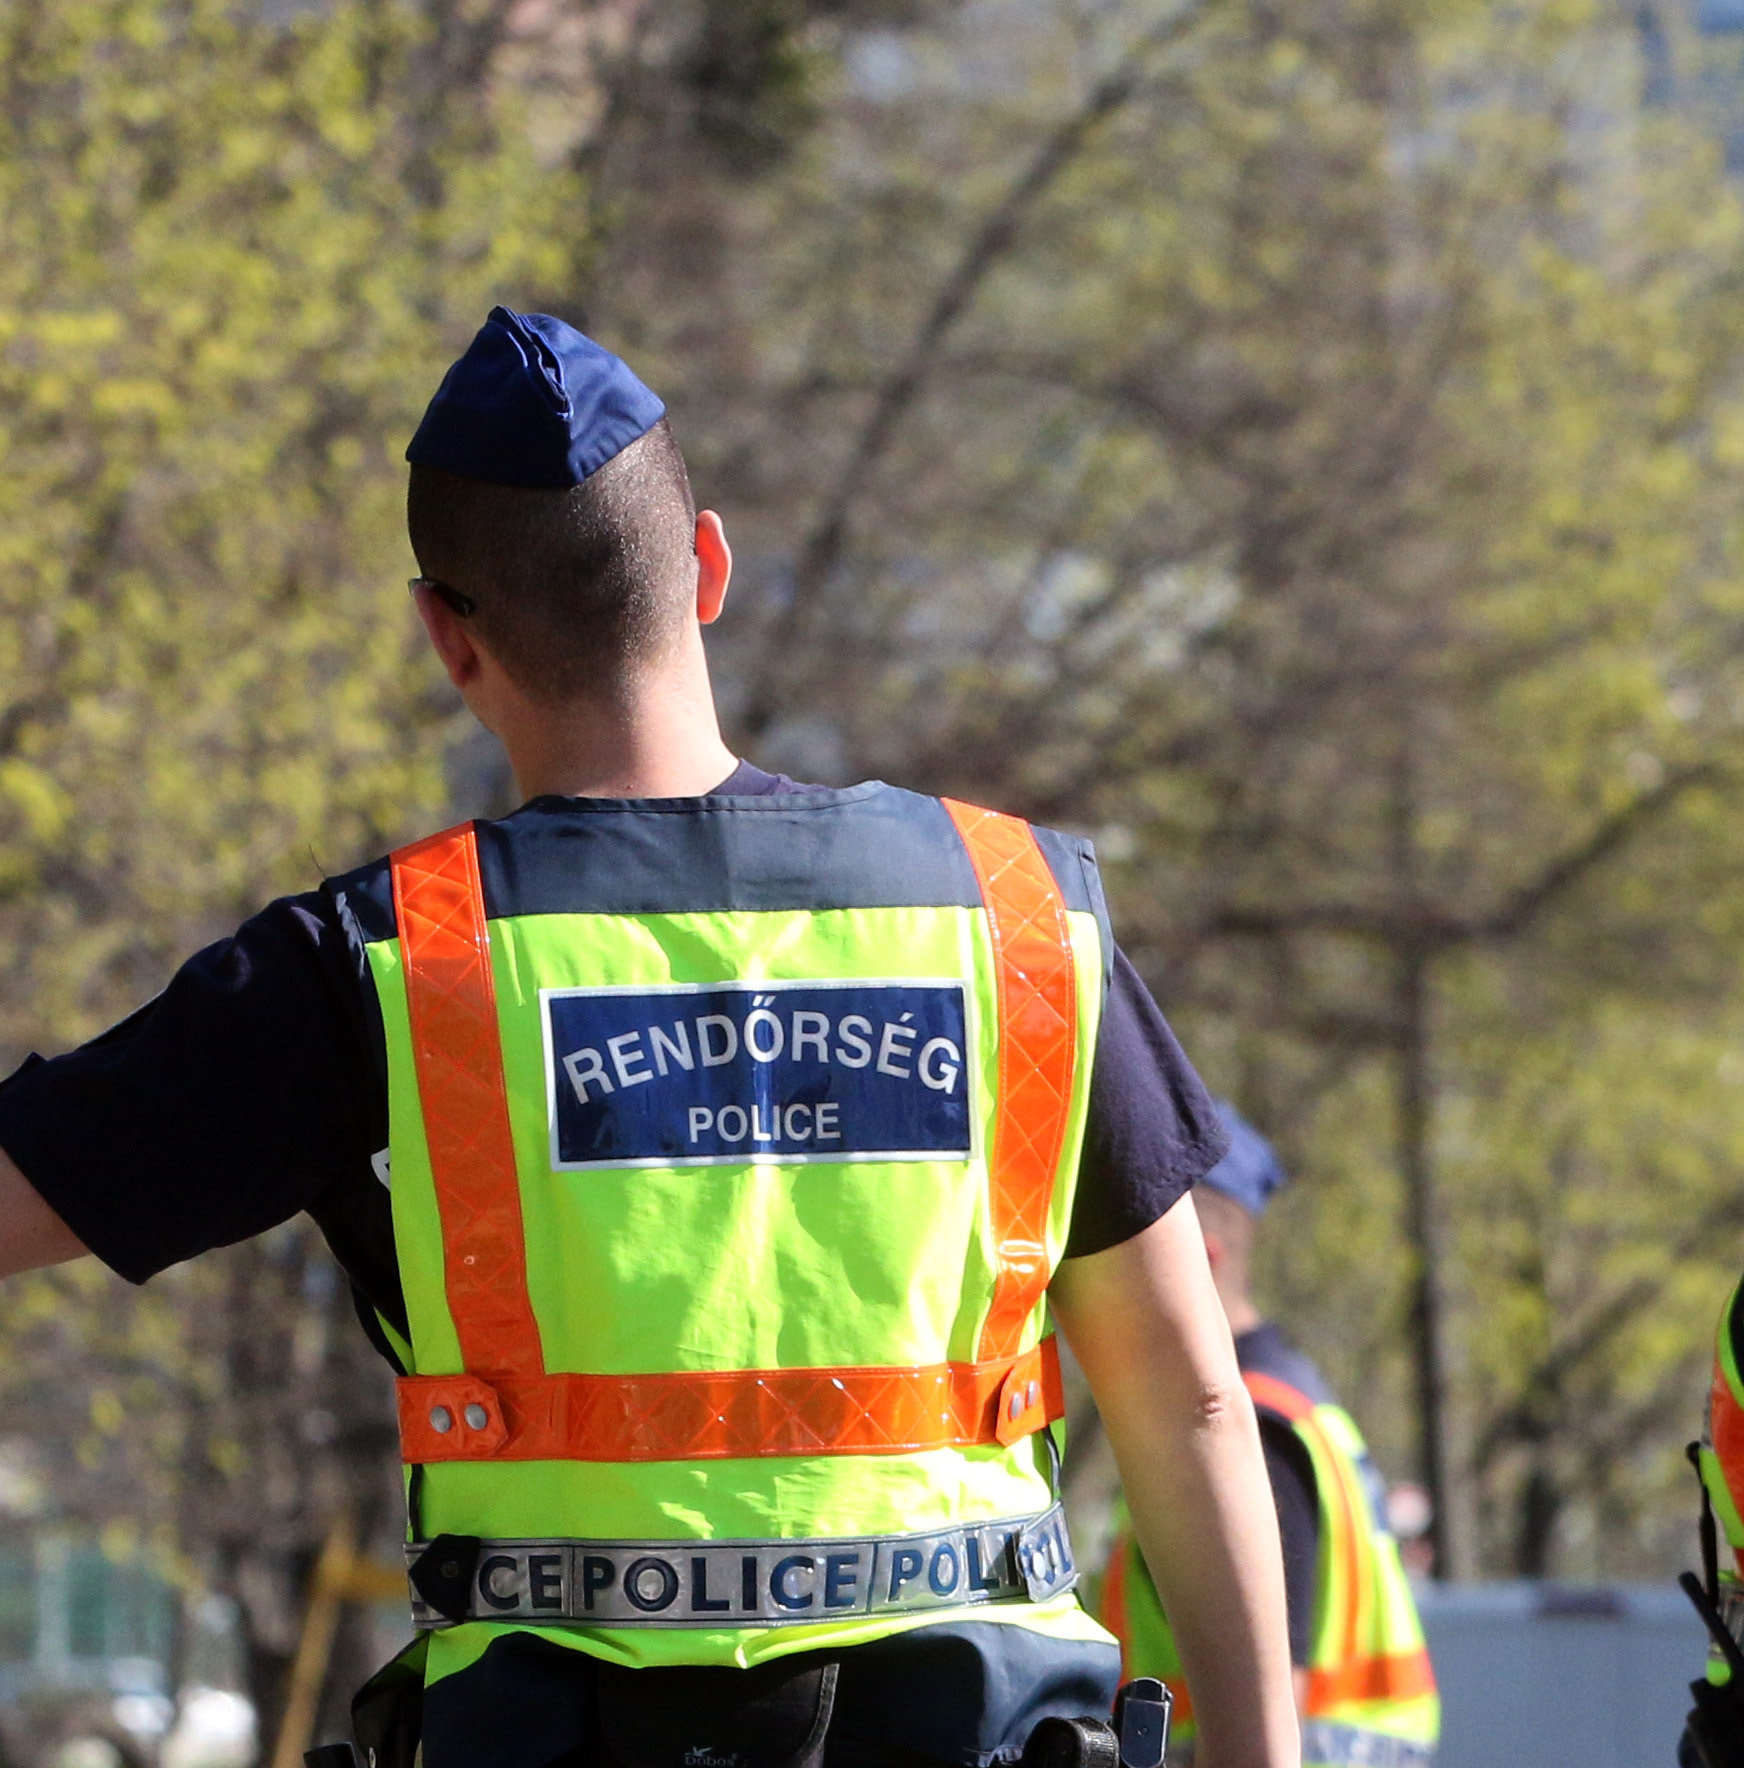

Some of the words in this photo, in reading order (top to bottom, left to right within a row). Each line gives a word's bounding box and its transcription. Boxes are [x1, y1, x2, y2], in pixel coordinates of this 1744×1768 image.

[562, 995, 960, 1104] RENDŐRSÉG
[688, 1103, 841, 1143] POLICE
[582, 1552, 859, 1613] POLICE
